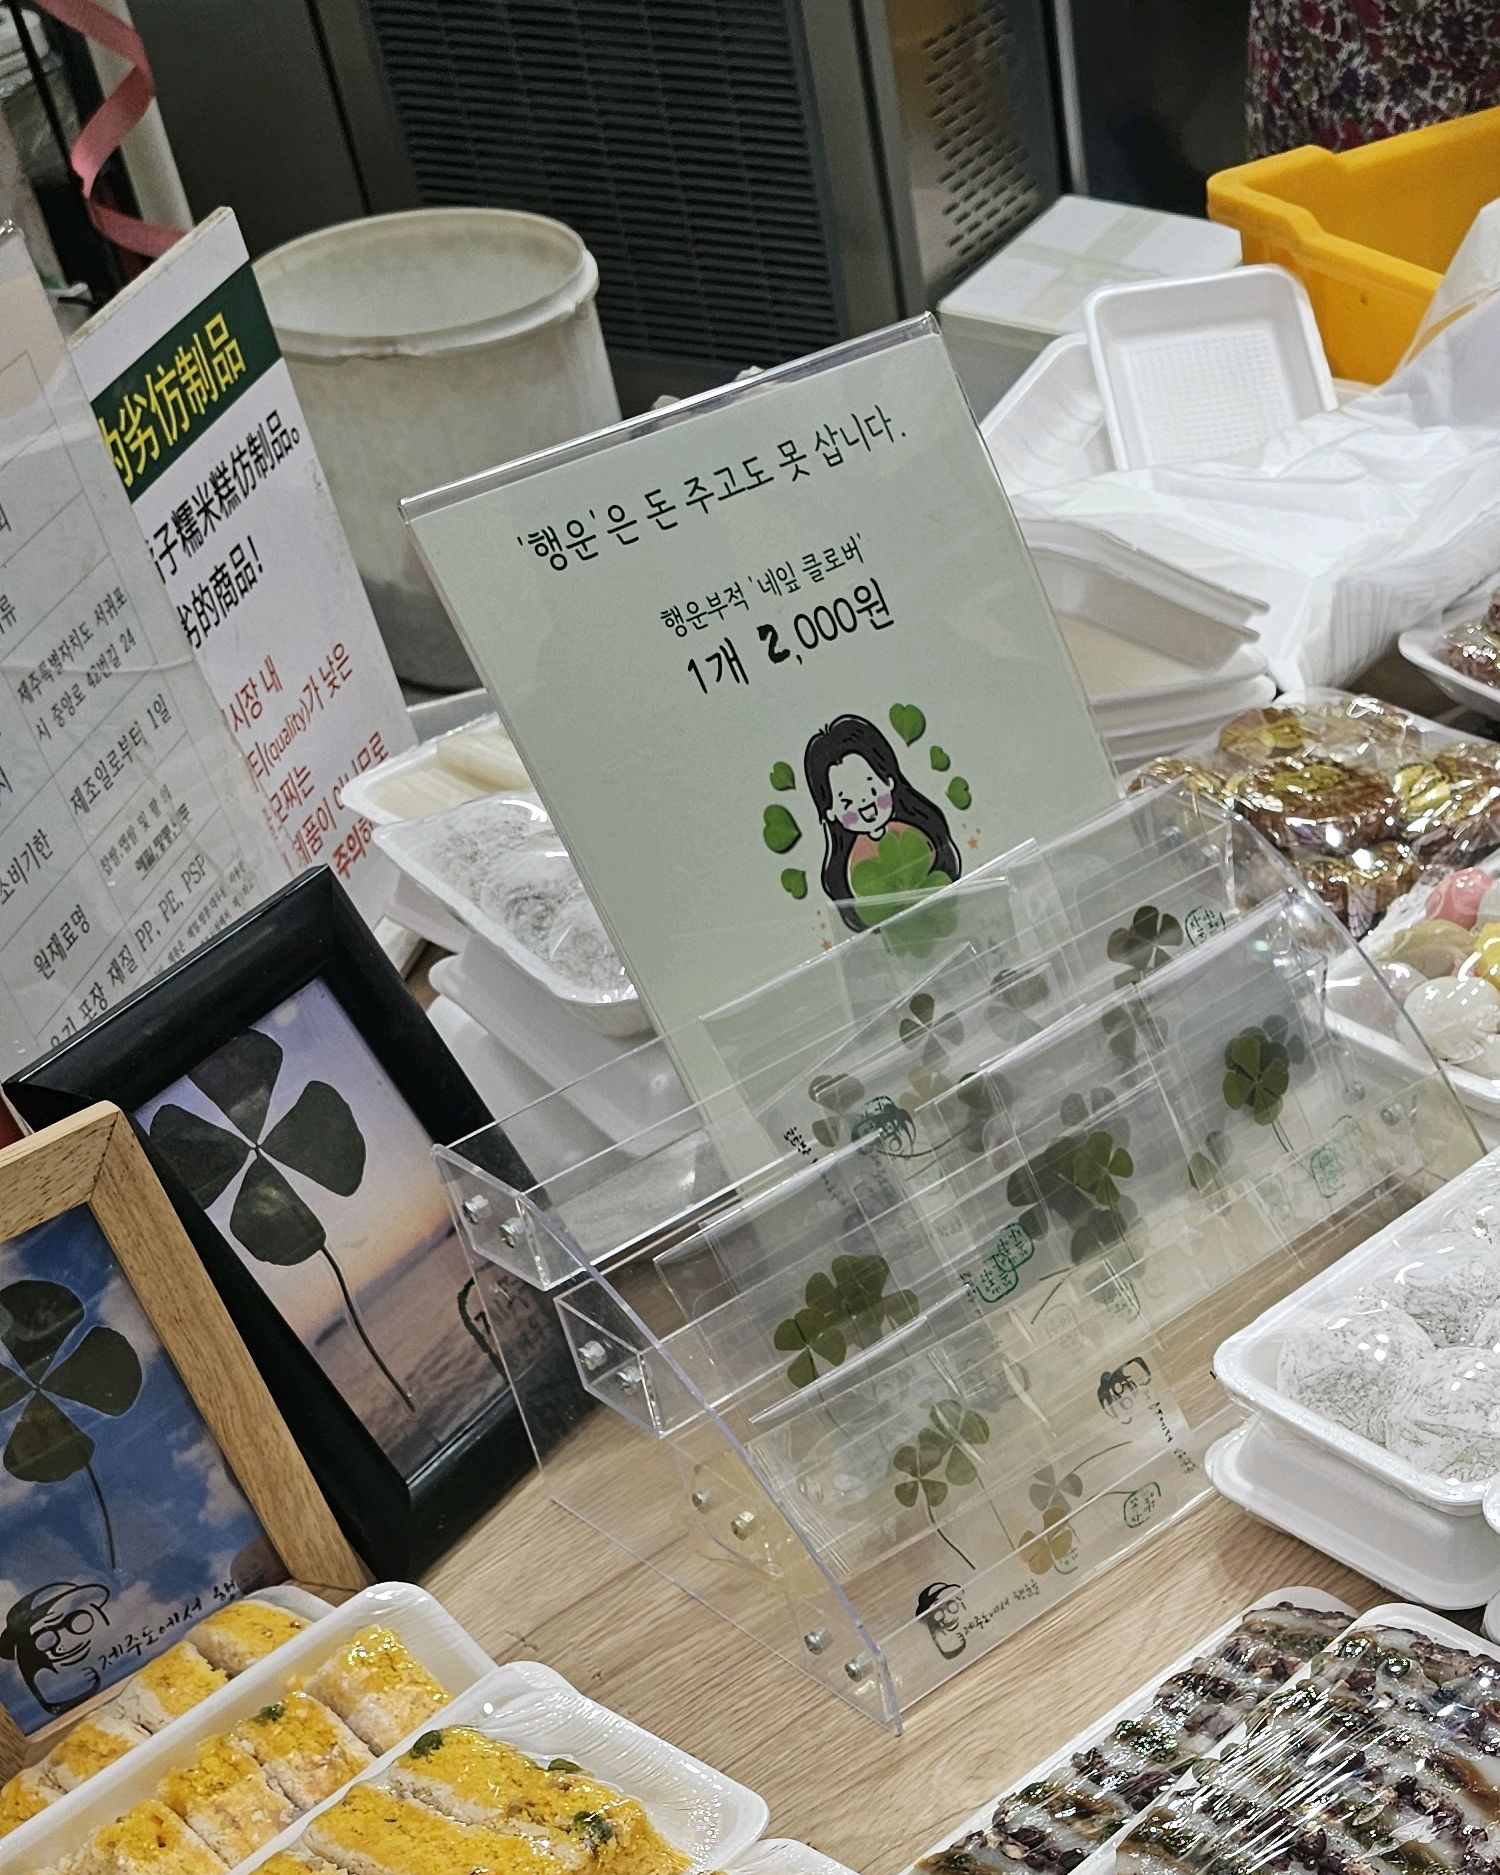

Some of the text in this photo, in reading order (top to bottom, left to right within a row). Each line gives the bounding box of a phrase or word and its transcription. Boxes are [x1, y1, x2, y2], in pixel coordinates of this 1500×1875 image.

[145, 409, 299, 584] 子糯米糕仿制品。
[517, 405, 906, 571] '행운'은 돈 주고도 못 삽니다.
[660, 532, 864, 637] 행운부적 '네잎 클로버'
[687, 578, 894, 694] 1개 2,000원
[17, 586, 128, 704] 제주특별자치도 서귀포
[36, 627, 136, 742] 시 중앙로 42번길 24
[222, 655, 283, 732] 시장 내
[69, 693, 173, 816] 제조일로부터 1일
[246, 643, 352, 788] 티(quality)가 낮은
[33, 904, 90, 980] 원재료명
[78, 982, 108, 1022] 포장
[107, 945, 138, 986] 재질
[180, 854, 205, 894] PSP
[98, 1598, 203, 1671] 제주도에서
